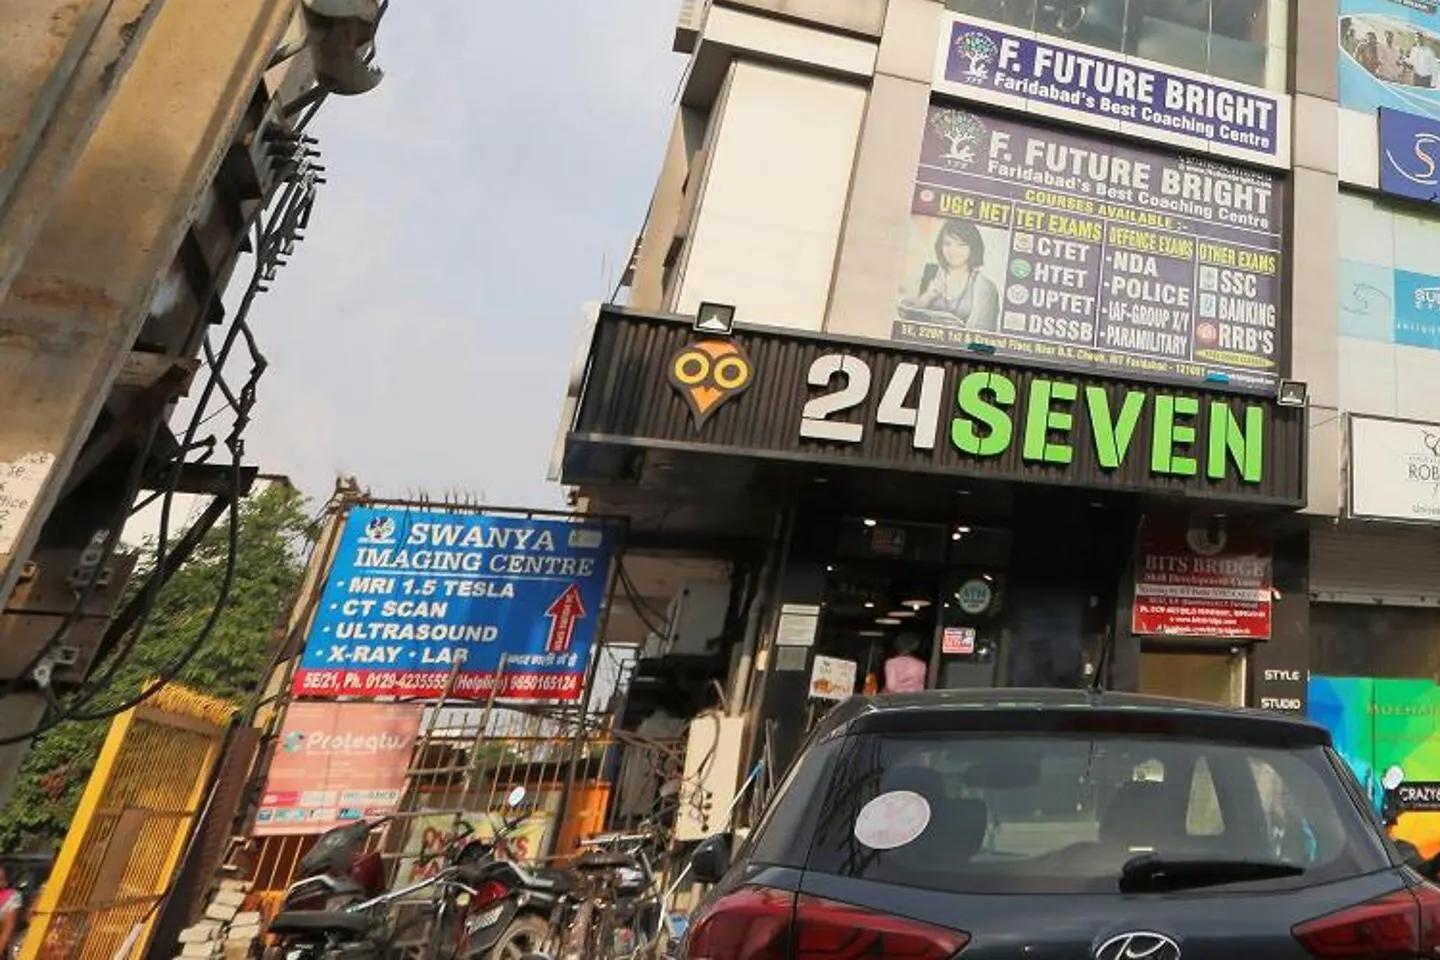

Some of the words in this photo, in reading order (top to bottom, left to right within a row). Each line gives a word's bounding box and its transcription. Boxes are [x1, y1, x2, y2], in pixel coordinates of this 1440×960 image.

[998, 38, 1021, 72] F.
[1033, 48, 1155, 104] FUTURE
[1165, 78, 1273, 130] BRIGHT
[993, 72, 1096, 108] Faridabad's
[1100, 95, 1136, 118] Best
[1142, 108, 1214, 139] Coaching
[1219, 125, 1270, 149] Centre
[990, 130, 1013, 161] F.
[1025, 138, 1151, 190] FUTURE
[1161, 167, 1271, 214] BRIGHT
[939, 193, 974, 216] UGC
[979, 200, 1010, 223] NET
[988, 159, 1091, 193] Faridabad's
[1096, 182, 1133, 202] Best
[1138, 191, 1213, 220] Coaching
[1218, 207, 1269, 229] Centre
[1025, 189, 1095, 214] COURSES
[1015, 207, 1045, 230] TET
[1048, 214, 1102, 241] EXAMS
[1038, 236, 1090, 262] CTET
[1109, 226, 1156, 251] DEFENCE
[1159, 236, 1193, 259] EXAMS
[1113, 250, 1159, 277] NDA
[1200, 243, 1236, 266] OTHER
[1238, 249, 1276, 273] EXAMS
[1034, 262, 1088, 288] HTET
[1220, 269, 1257, 299] SSC
[1032, 287, 1095, 315] UPTET
[1111, 275, 1190, 307] POLICE
[1219, 296, 1276, 328] BANKING
[1028, 314, 1094, 342] DSSSB
[1218, 322, 1274, 355] RRB'S
[407, 522, 555, 551] SWANYA
[353, 547, 482, 571] IMAGING
[489, 554, 594, 577] CENTRE
[348, 576, 396, 594] MRI
[402, 578, 438, 595] 1.5
[444, 581, 515, 598] TESLA
[343, 599, 376, 616] CT
[381, 601, 448, 618] SCAN
[335, 621, 498, 642] ULTRASOUND
[328, 644, 402, 663] X-RAY
[1264, 669, 1300, 681] STYLE
[1261, 697, 1301, 709] STUDIO
